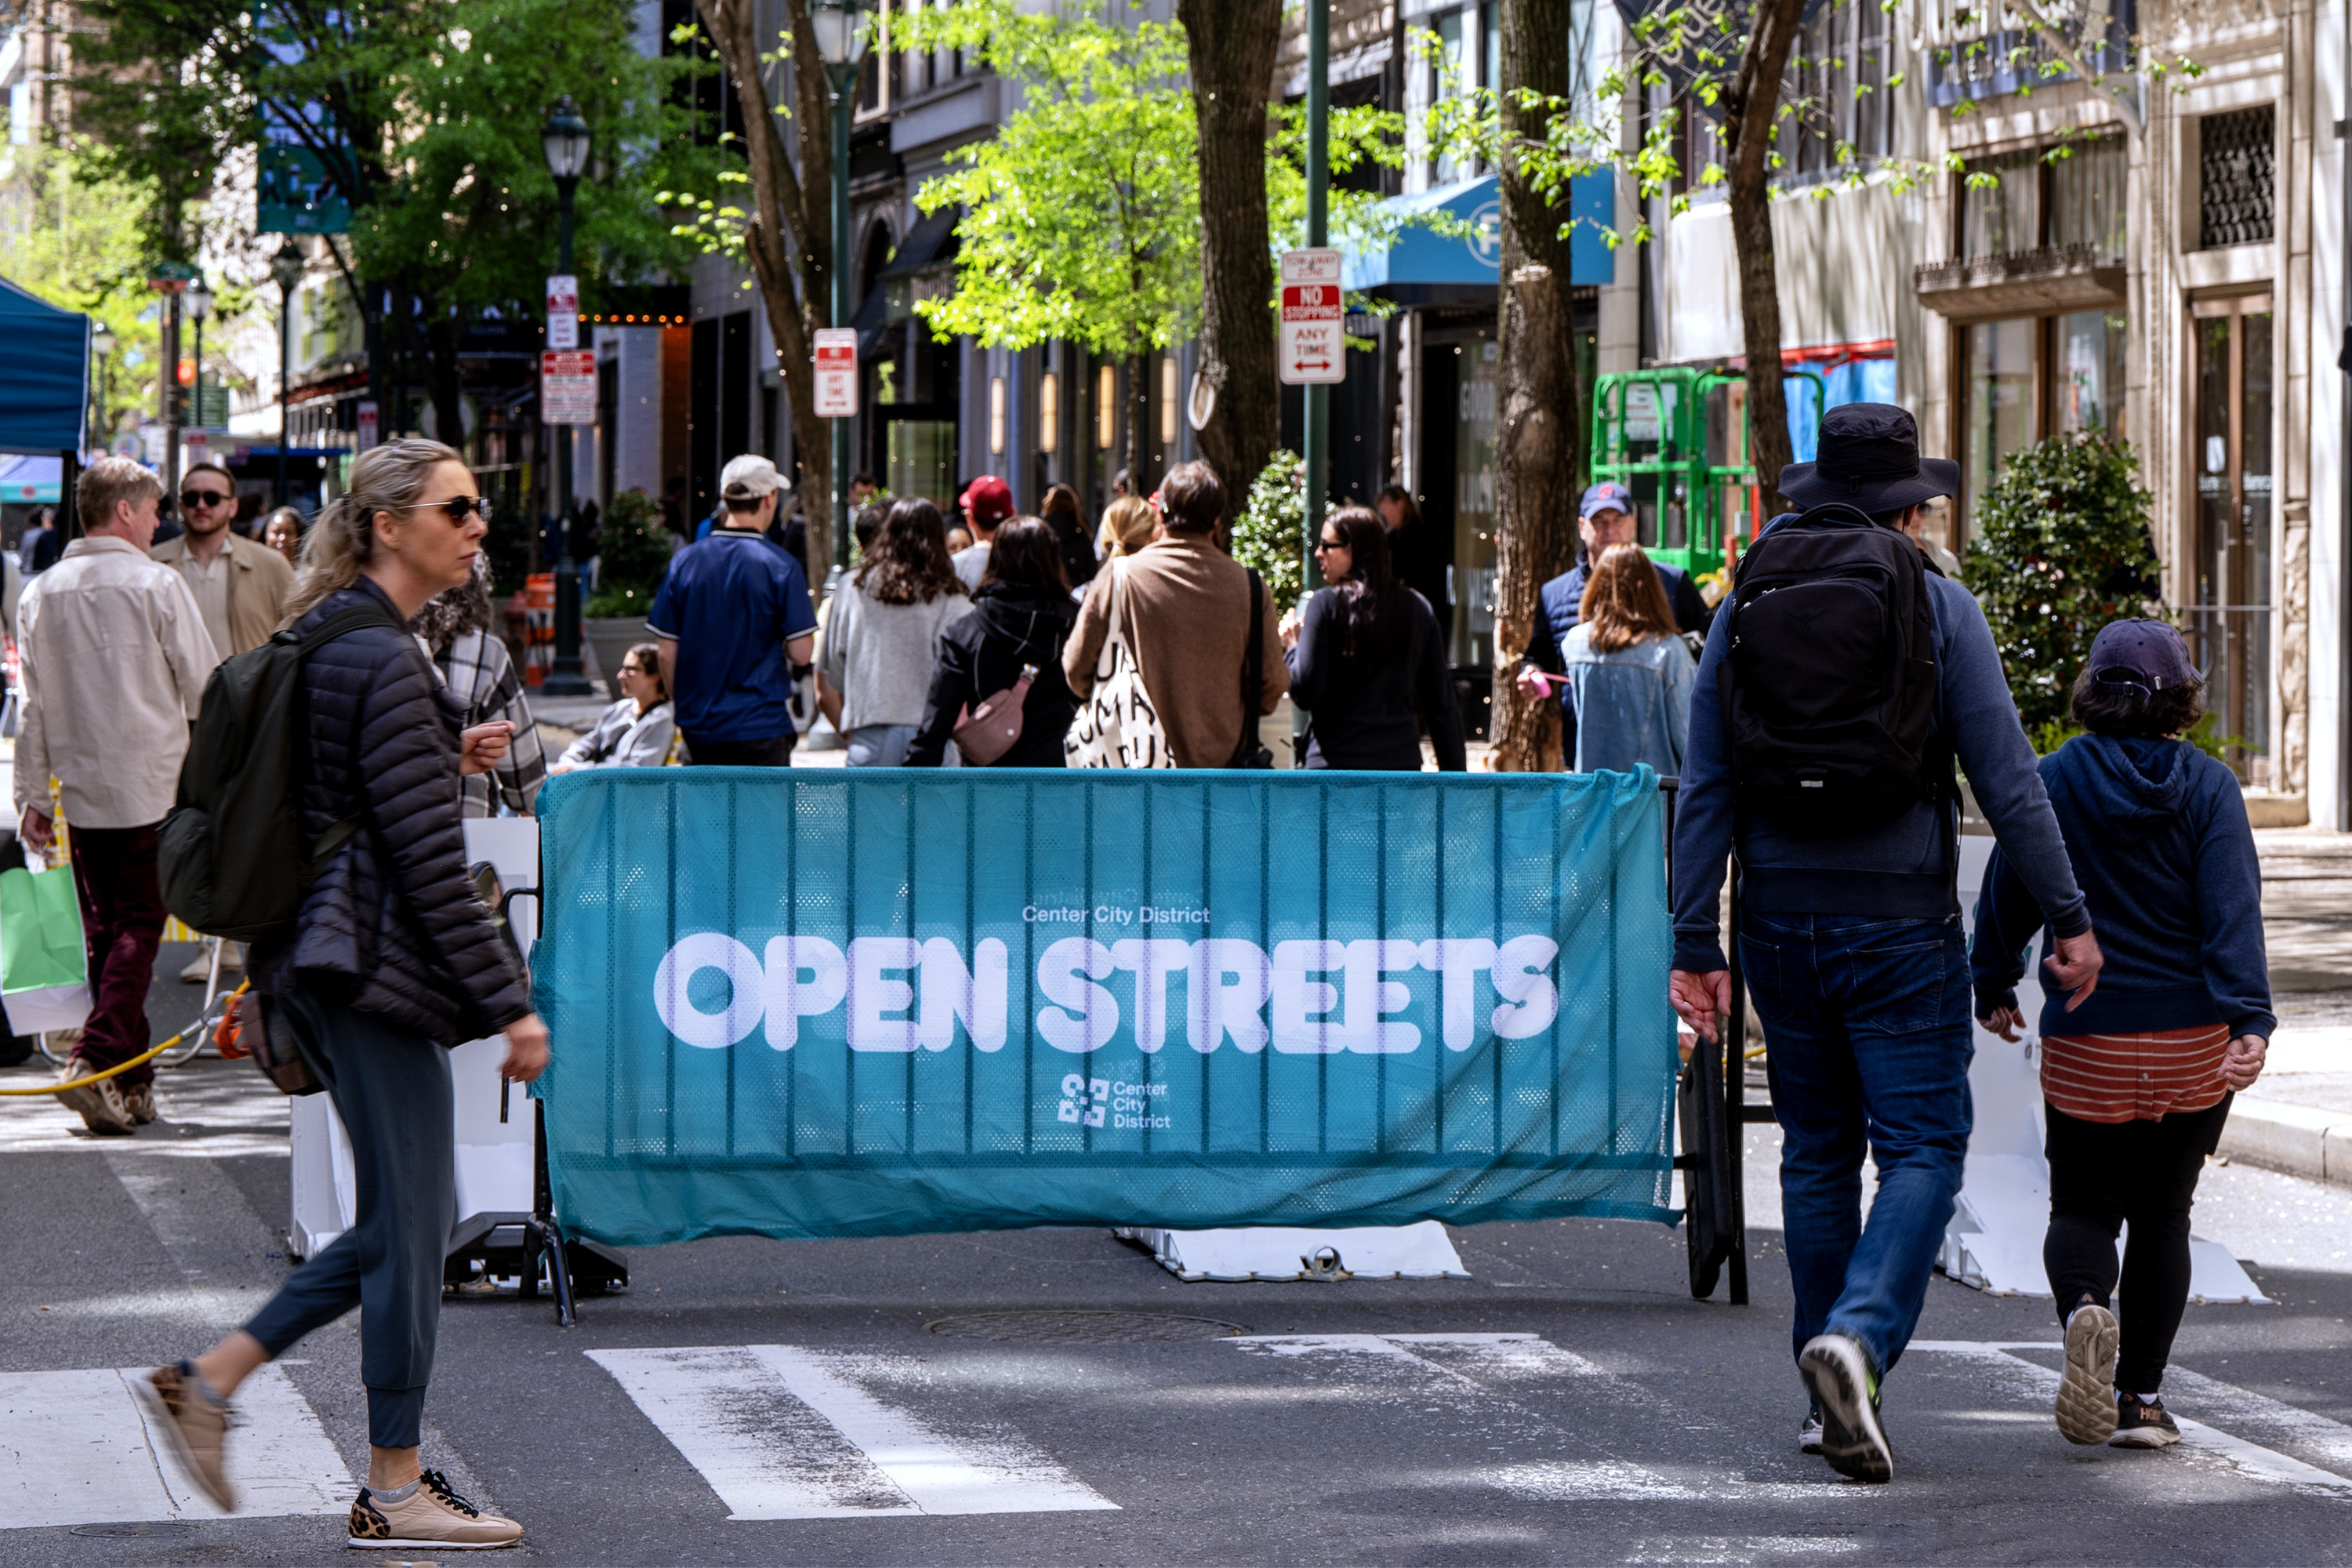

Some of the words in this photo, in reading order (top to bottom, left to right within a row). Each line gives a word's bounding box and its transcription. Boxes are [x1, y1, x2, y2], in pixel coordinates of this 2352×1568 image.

[1300, 286, 1323, 306] NO
[1283, 304, 1340, 321] STOPPING
[1295, 328, 1330, 341] ANY
[1295, 343, 1331, 357] TIME
[1022, 906, 1088, 922] Center
[1094, 906, 1133, 926] City
[1139, 906, 1210, 923] District
[654, 932, 1007, 1053] OPEN
[1036, 935, 1559, 1054] STREETS
[1113, 1081, 1167, 1095] Center
[1113, 1098, 1146, 1113] City
[1113, 1113, 1171, 1128] District
